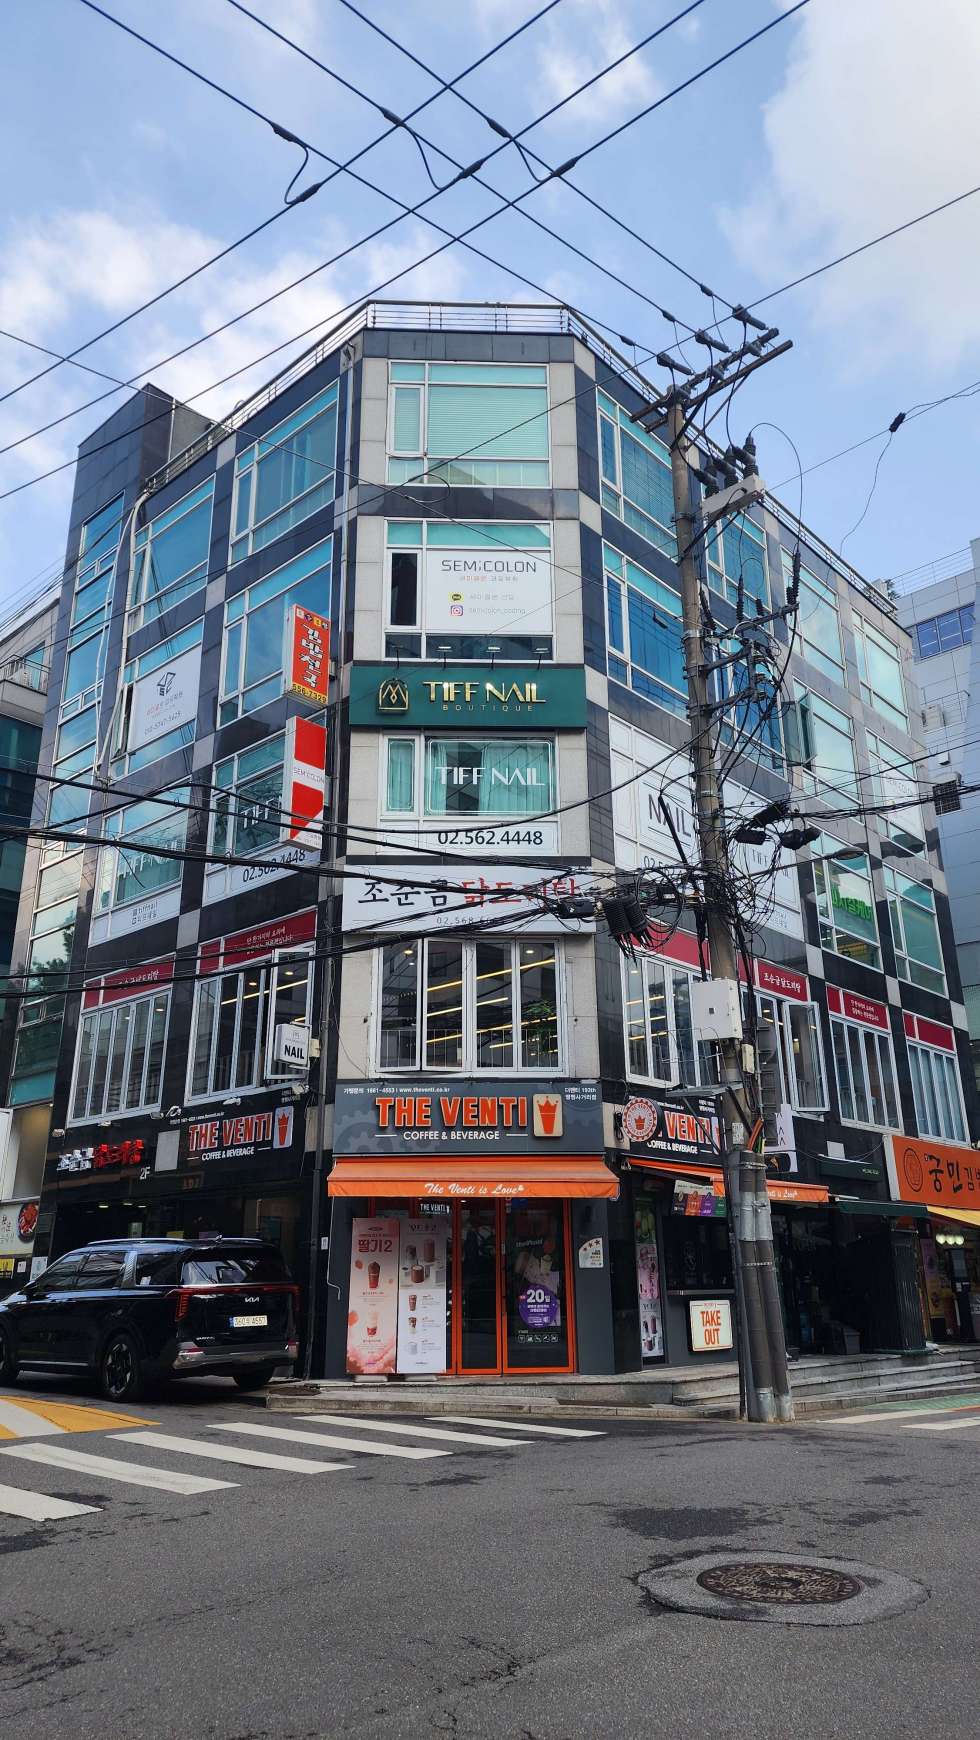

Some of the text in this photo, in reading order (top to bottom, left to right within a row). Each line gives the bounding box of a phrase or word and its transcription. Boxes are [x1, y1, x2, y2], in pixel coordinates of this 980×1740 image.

[423, 681, 547, 703] TIFF NAIL
[443, 704, 533, 712] BOUTIQUE
[435, 766, 546, 786] TIFF NAIL
[437, 831, 544, 845] 02.562.4448
[284, 1044, 305, 1060] NAIL
[375, 1096, 528, 1128] THE VENTI
[188, 1112, 273, 1152] THE VENTI
[403, 1131, 500, 1140] COFFEE & BEVERAGE
[664, 1110, 712, 1145] VENTI
[140, 1166, 151, 1180] 2F
[424, 1182, 444, 1194] The
[448, 1182, 475, 1194] Venti
[479, 1184, 488, 1194] is
[700, 1309, 722, 1327] TAKE
[703, 1327, 720, 1346] OUT
